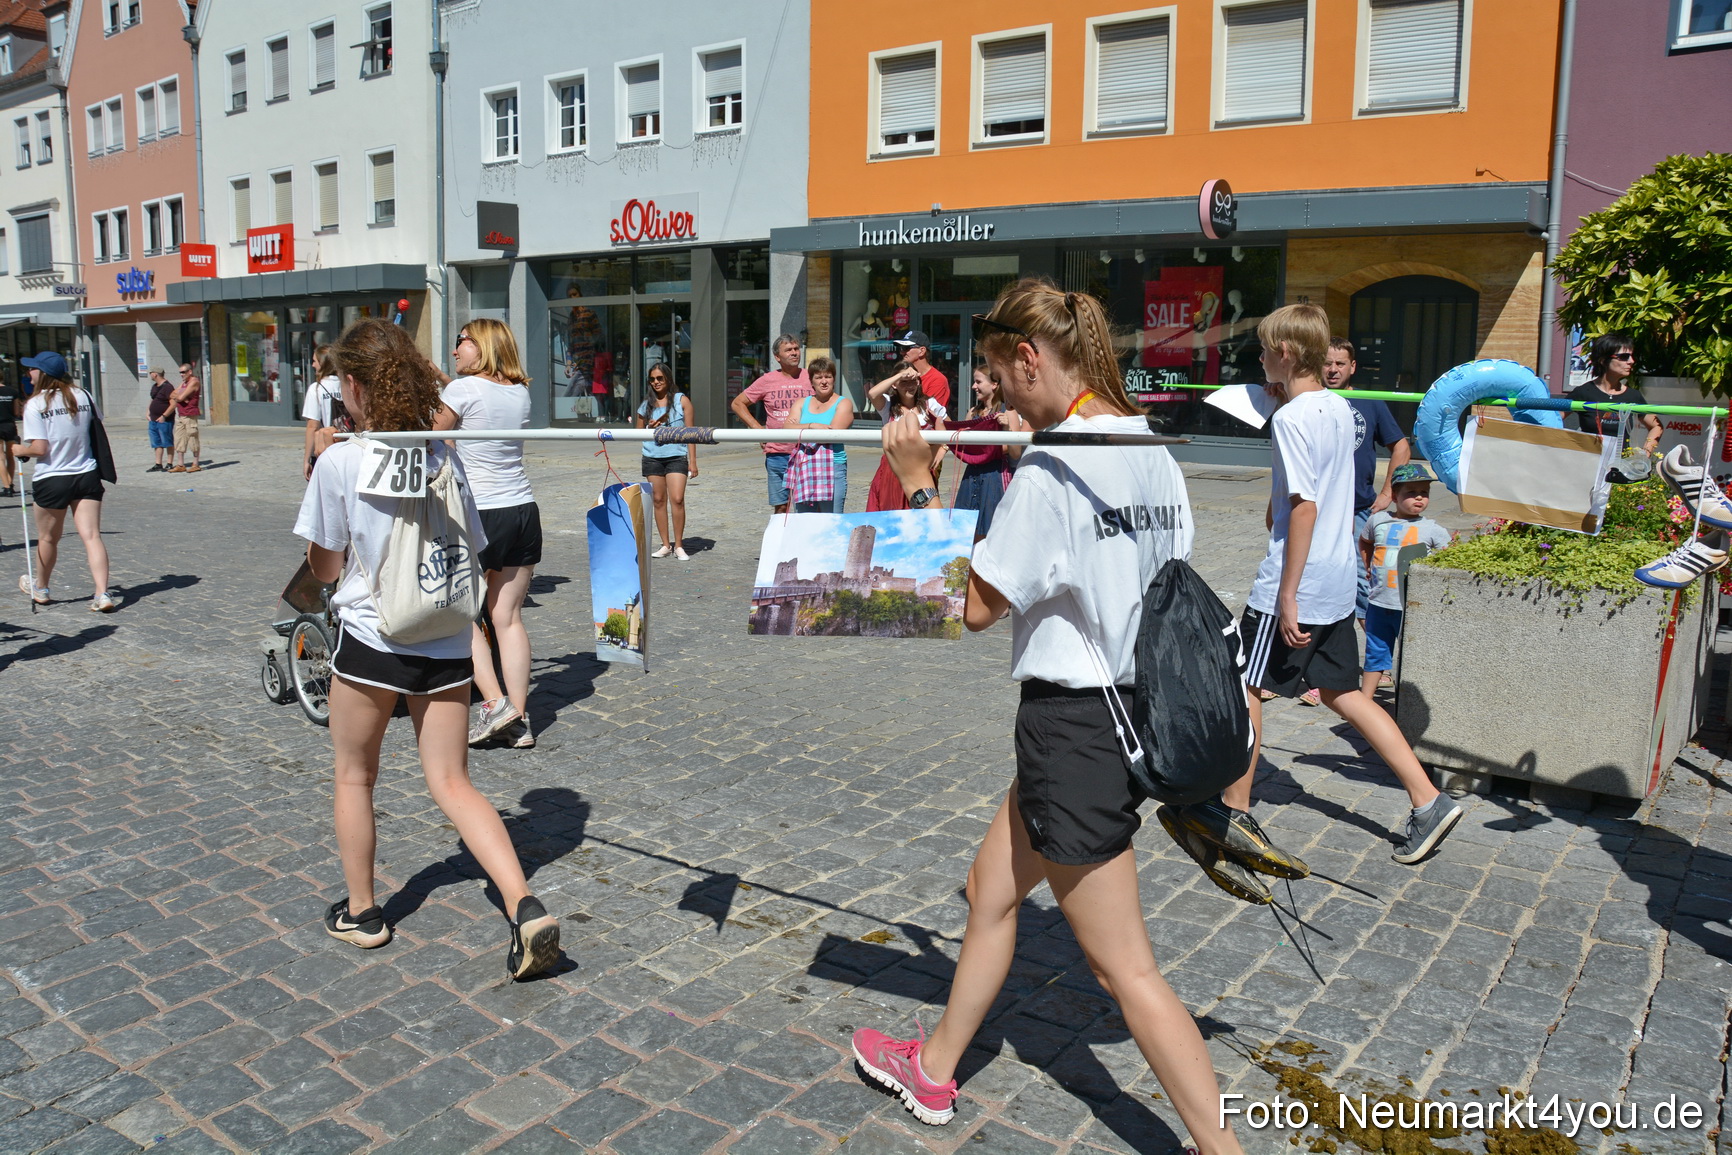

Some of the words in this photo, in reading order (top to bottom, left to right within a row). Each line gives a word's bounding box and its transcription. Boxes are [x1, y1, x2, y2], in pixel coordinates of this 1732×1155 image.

[609, 198, 697, 243] s.Oliver
[859, 215, 994, 246] hunkemöller
[248, 233, 281, 257] WITT
[188, 254, 212, 264] WITT
[1147, 303, 1191, 328] SALE
[770, 390, 812, 400] SUNSET
[1125, 375, 1153, 391] SALE
[367, 447, 423, 493] 736
[434, 585, 471, 610] TEAMSPIRIT
